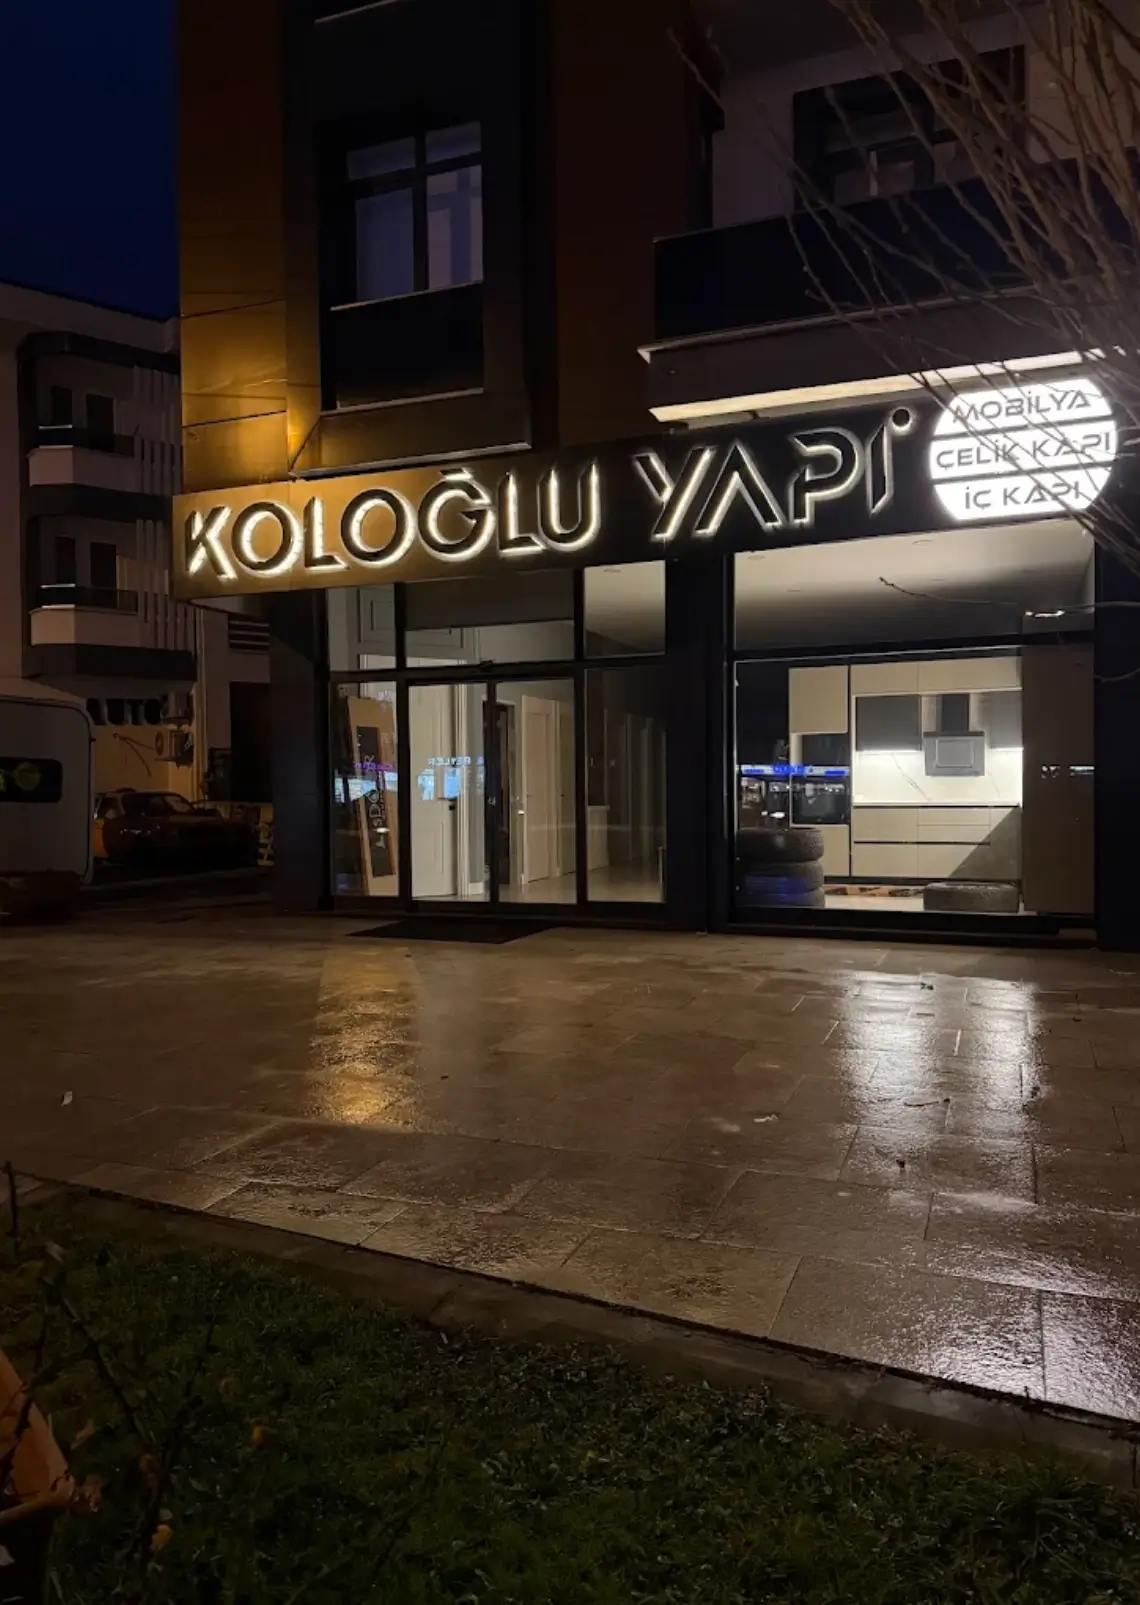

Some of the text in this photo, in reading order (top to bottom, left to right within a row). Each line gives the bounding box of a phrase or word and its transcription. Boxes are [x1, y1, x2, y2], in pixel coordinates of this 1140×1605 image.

[951, 389, 1092, 423] MOBİLYA
[936, 431, 1111, 470] ÇELİK KAPI
[964, 481, 1080, 509] İÇ KAPI
[184, 463, 599, 581] KOLOĞLU
